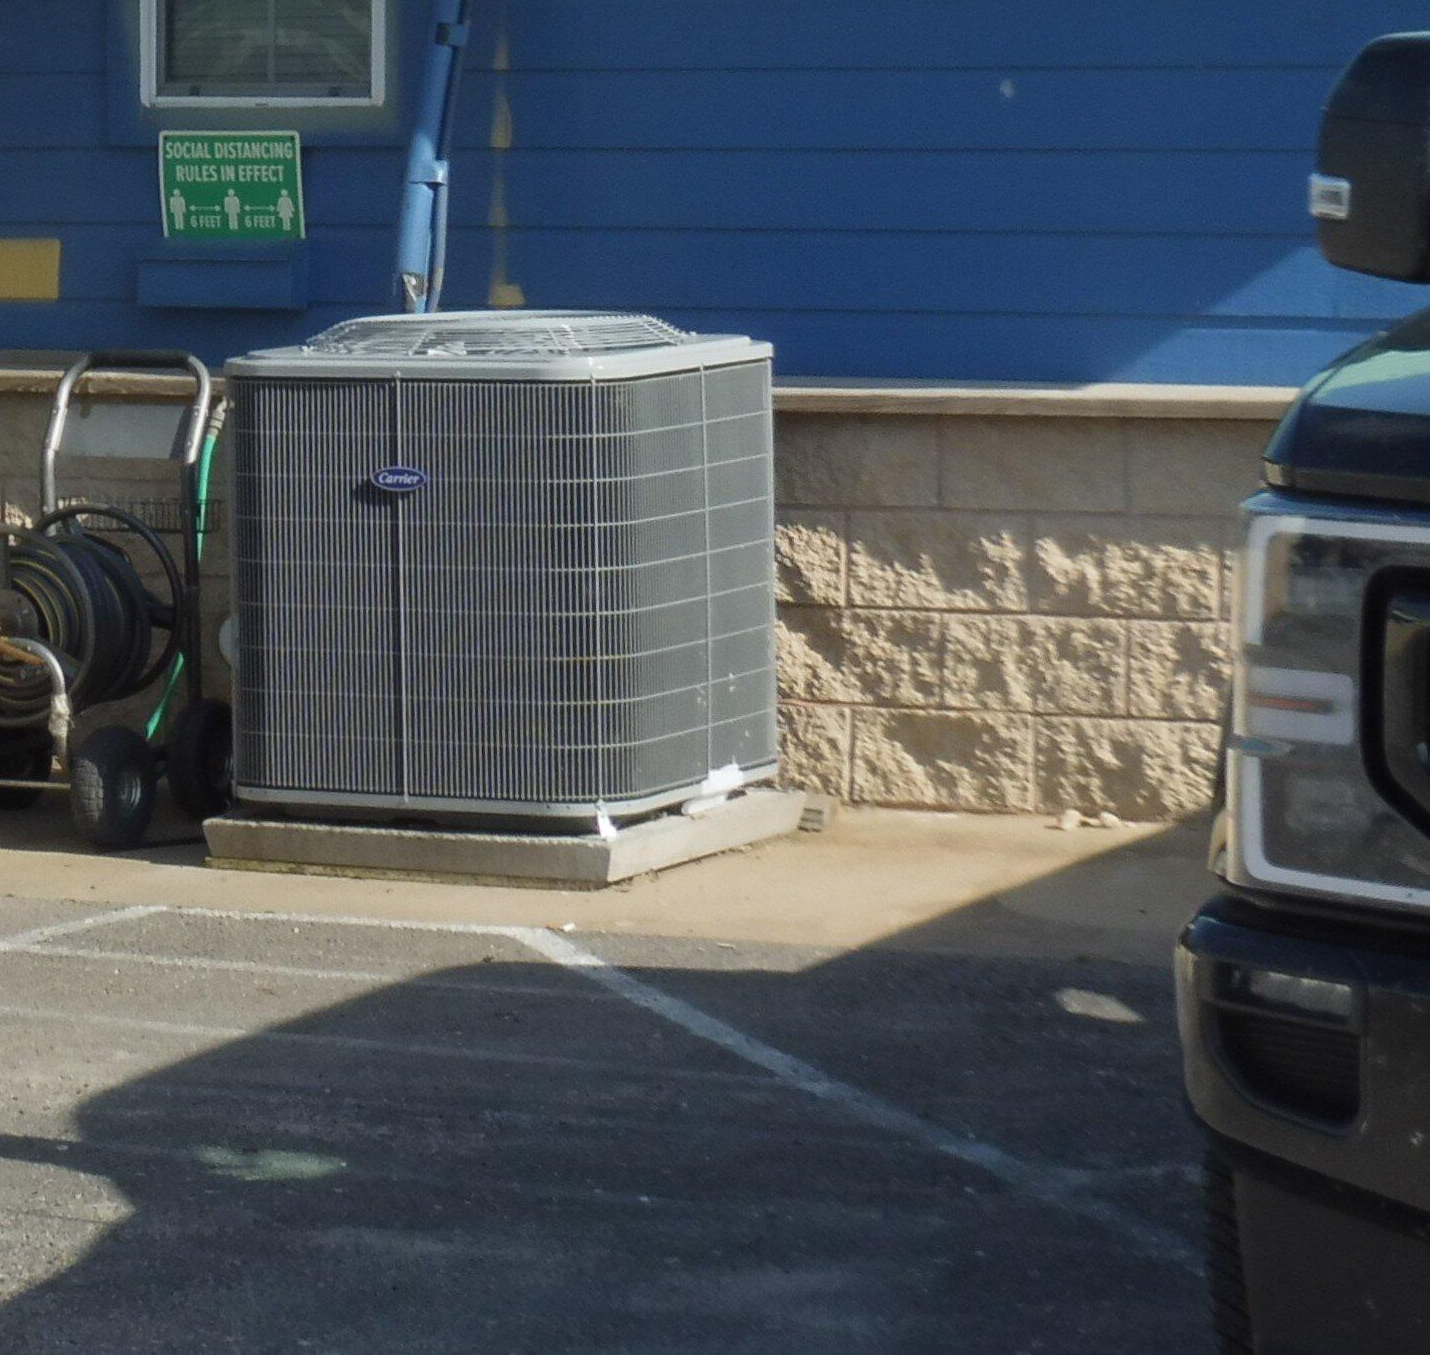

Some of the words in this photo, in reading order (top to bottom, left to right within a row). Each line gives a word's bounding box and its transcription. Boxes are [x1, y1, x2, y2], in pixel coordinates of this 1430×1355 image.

[166, 142, 211, 159] SOCIAL
[215, 142, 293, 159] DISTANCING
[176, 165, 217, 182] RULES
[221, 165, 235, 182] IN
[238, 165, 284, 182] EFFECT
[190, 216, 198, 227] 6
[200, 215, 222, 227] FEET
[245, 216, 252, 227] 6
[254, 216, 276, 227] FEET
[378, 472, 419, 484] Carrier
